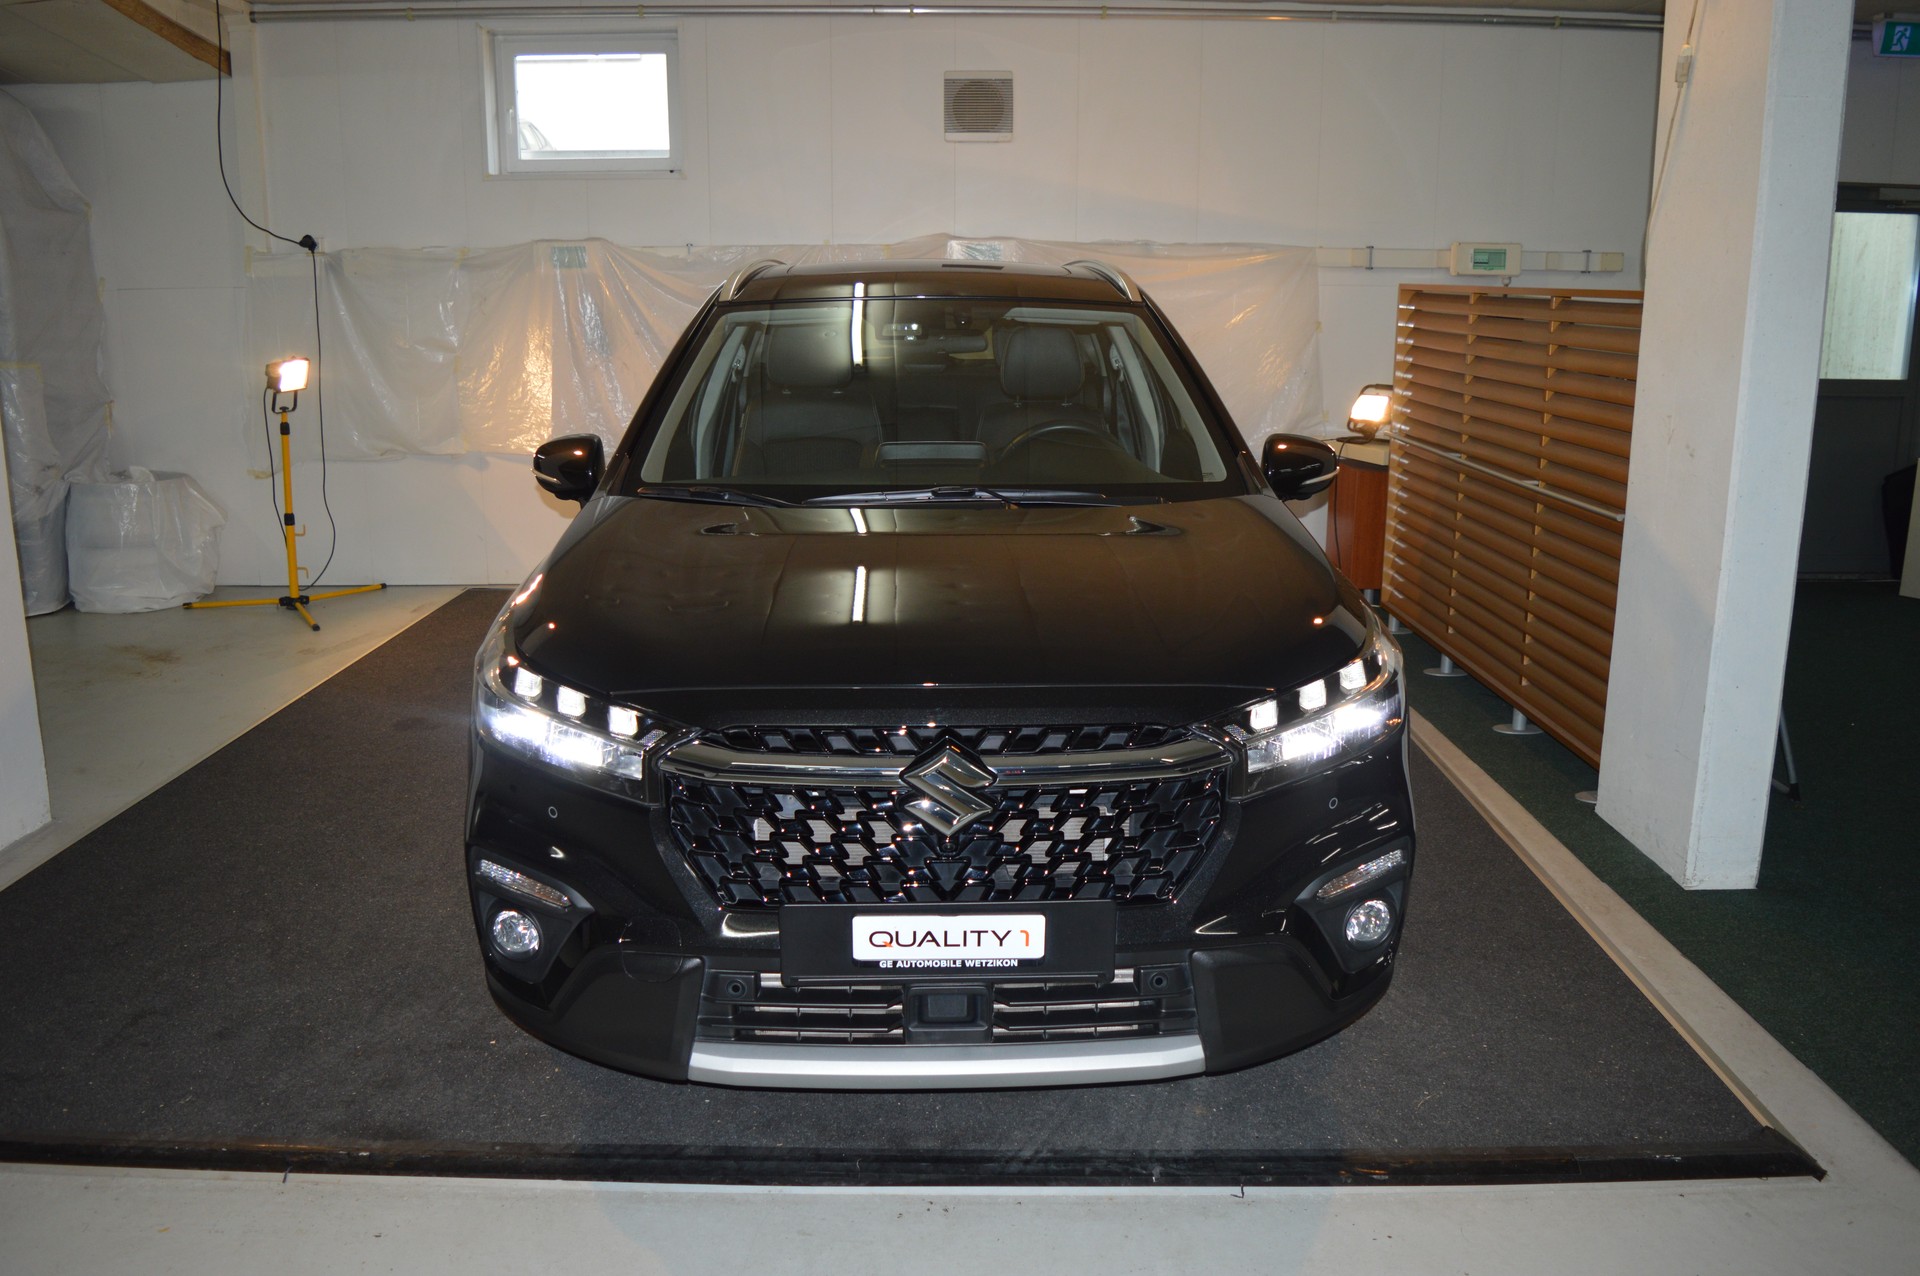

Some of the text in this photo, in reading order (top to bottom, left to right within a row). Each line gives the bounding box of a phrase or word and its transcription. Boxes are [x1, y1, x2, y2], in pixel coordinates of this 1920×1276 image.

[868, 929, 1030, 948] QUALITY 1
[879, 959, 1018, 968] GE AUTOMOBILE WETZIKON
